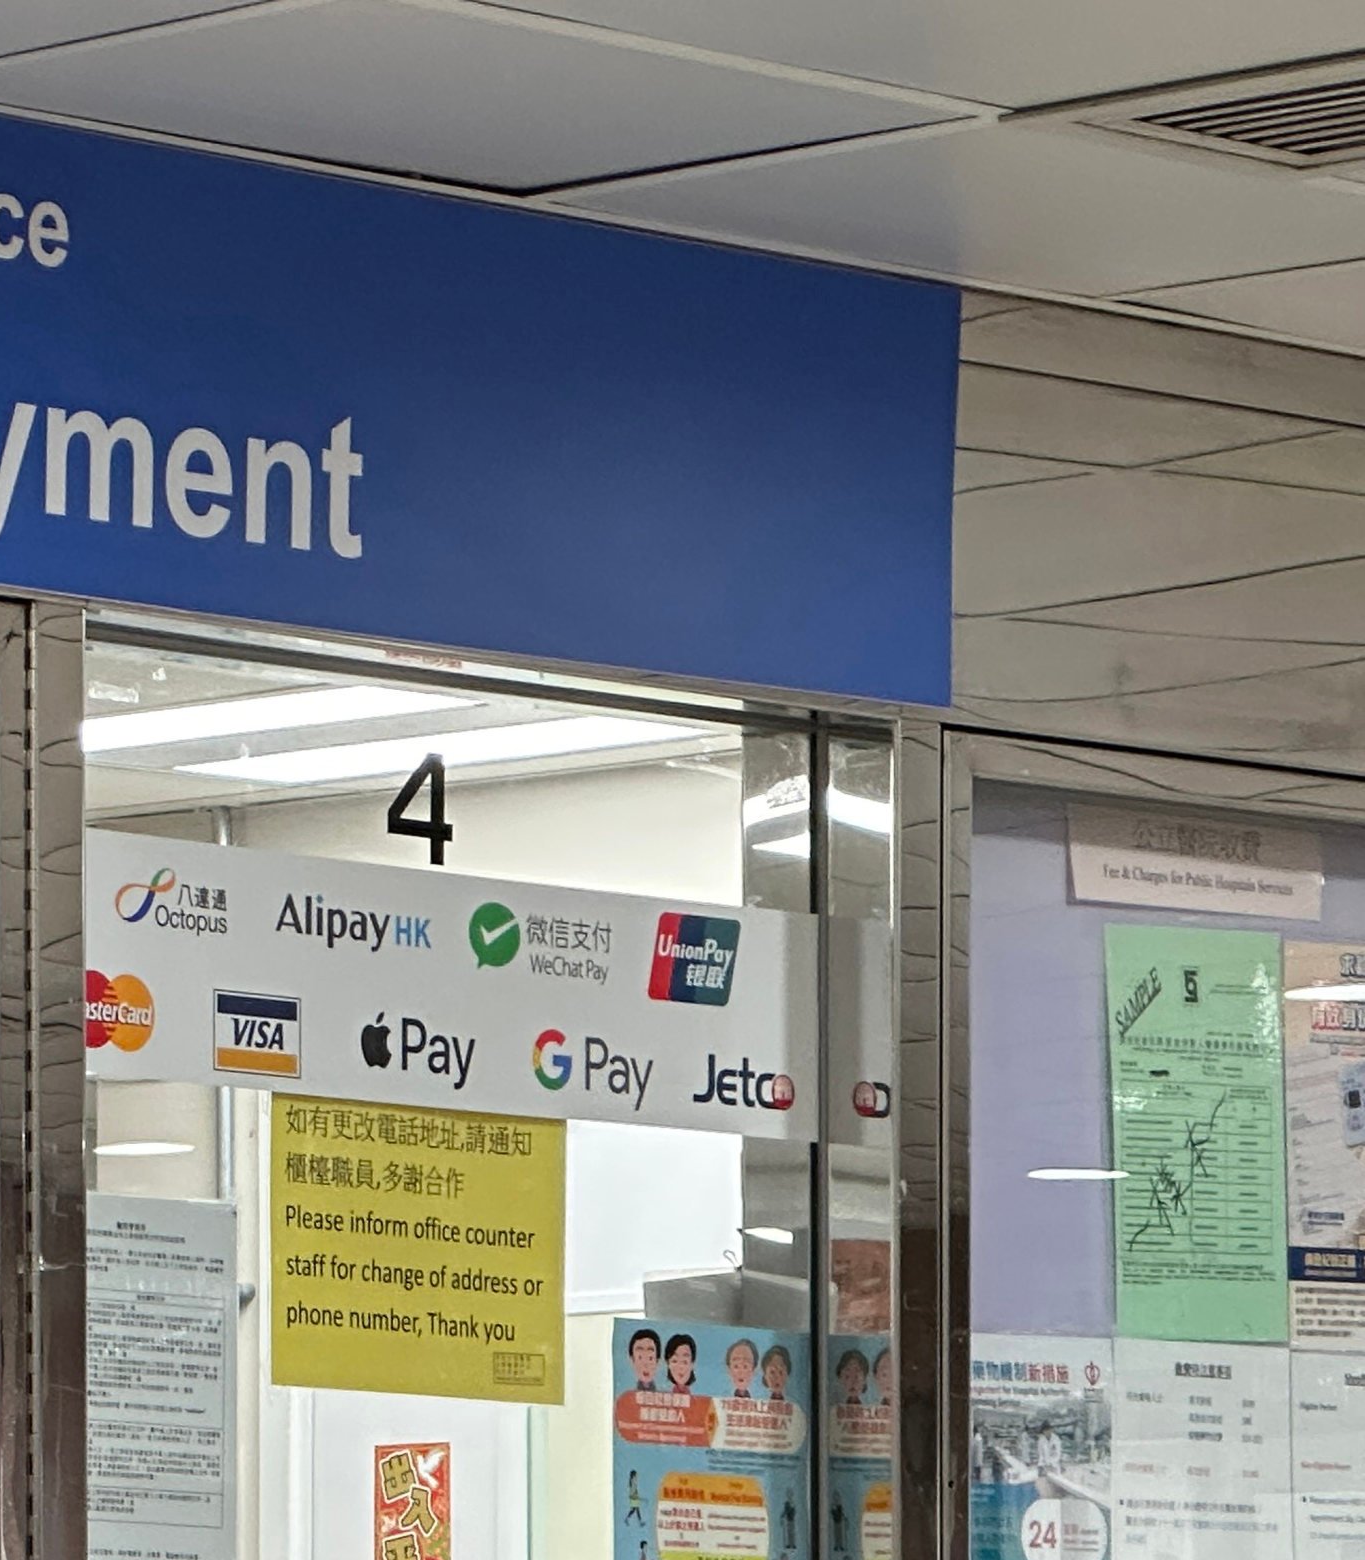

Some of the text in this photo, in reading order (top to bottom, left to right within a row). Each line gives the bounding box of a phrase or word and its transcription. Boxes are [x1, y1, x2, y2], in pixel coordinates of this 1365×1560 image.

[387, 752, 454, 866] 4
[177, 883, 227, 911] 八達通
[154, 904, 228, 936] Octopus
[275, 893, 432, 952] Alipay HK
[526, 914, 612, 954] 微信支付
[529, 954, 610, 986] WeChat Pay
[658, 932, 735, 974] UnionPay
[85, 1000, 153, 1026] asterCard
[230, 1017, 284, 1051] VISA
[401, 1016, 476, 1090] Pay
[585, 1037, 655, 1113] Pay
[694, 1054, 797, 1112] Jetco
[285, 1204, 535, 1249] Please inform office counter
[285, 1254, 543, 1297] staff for change of address or
[286, 1301, 515, 1345] phone number, Thank you
[1029, 1519, 1058, 1549] 24
